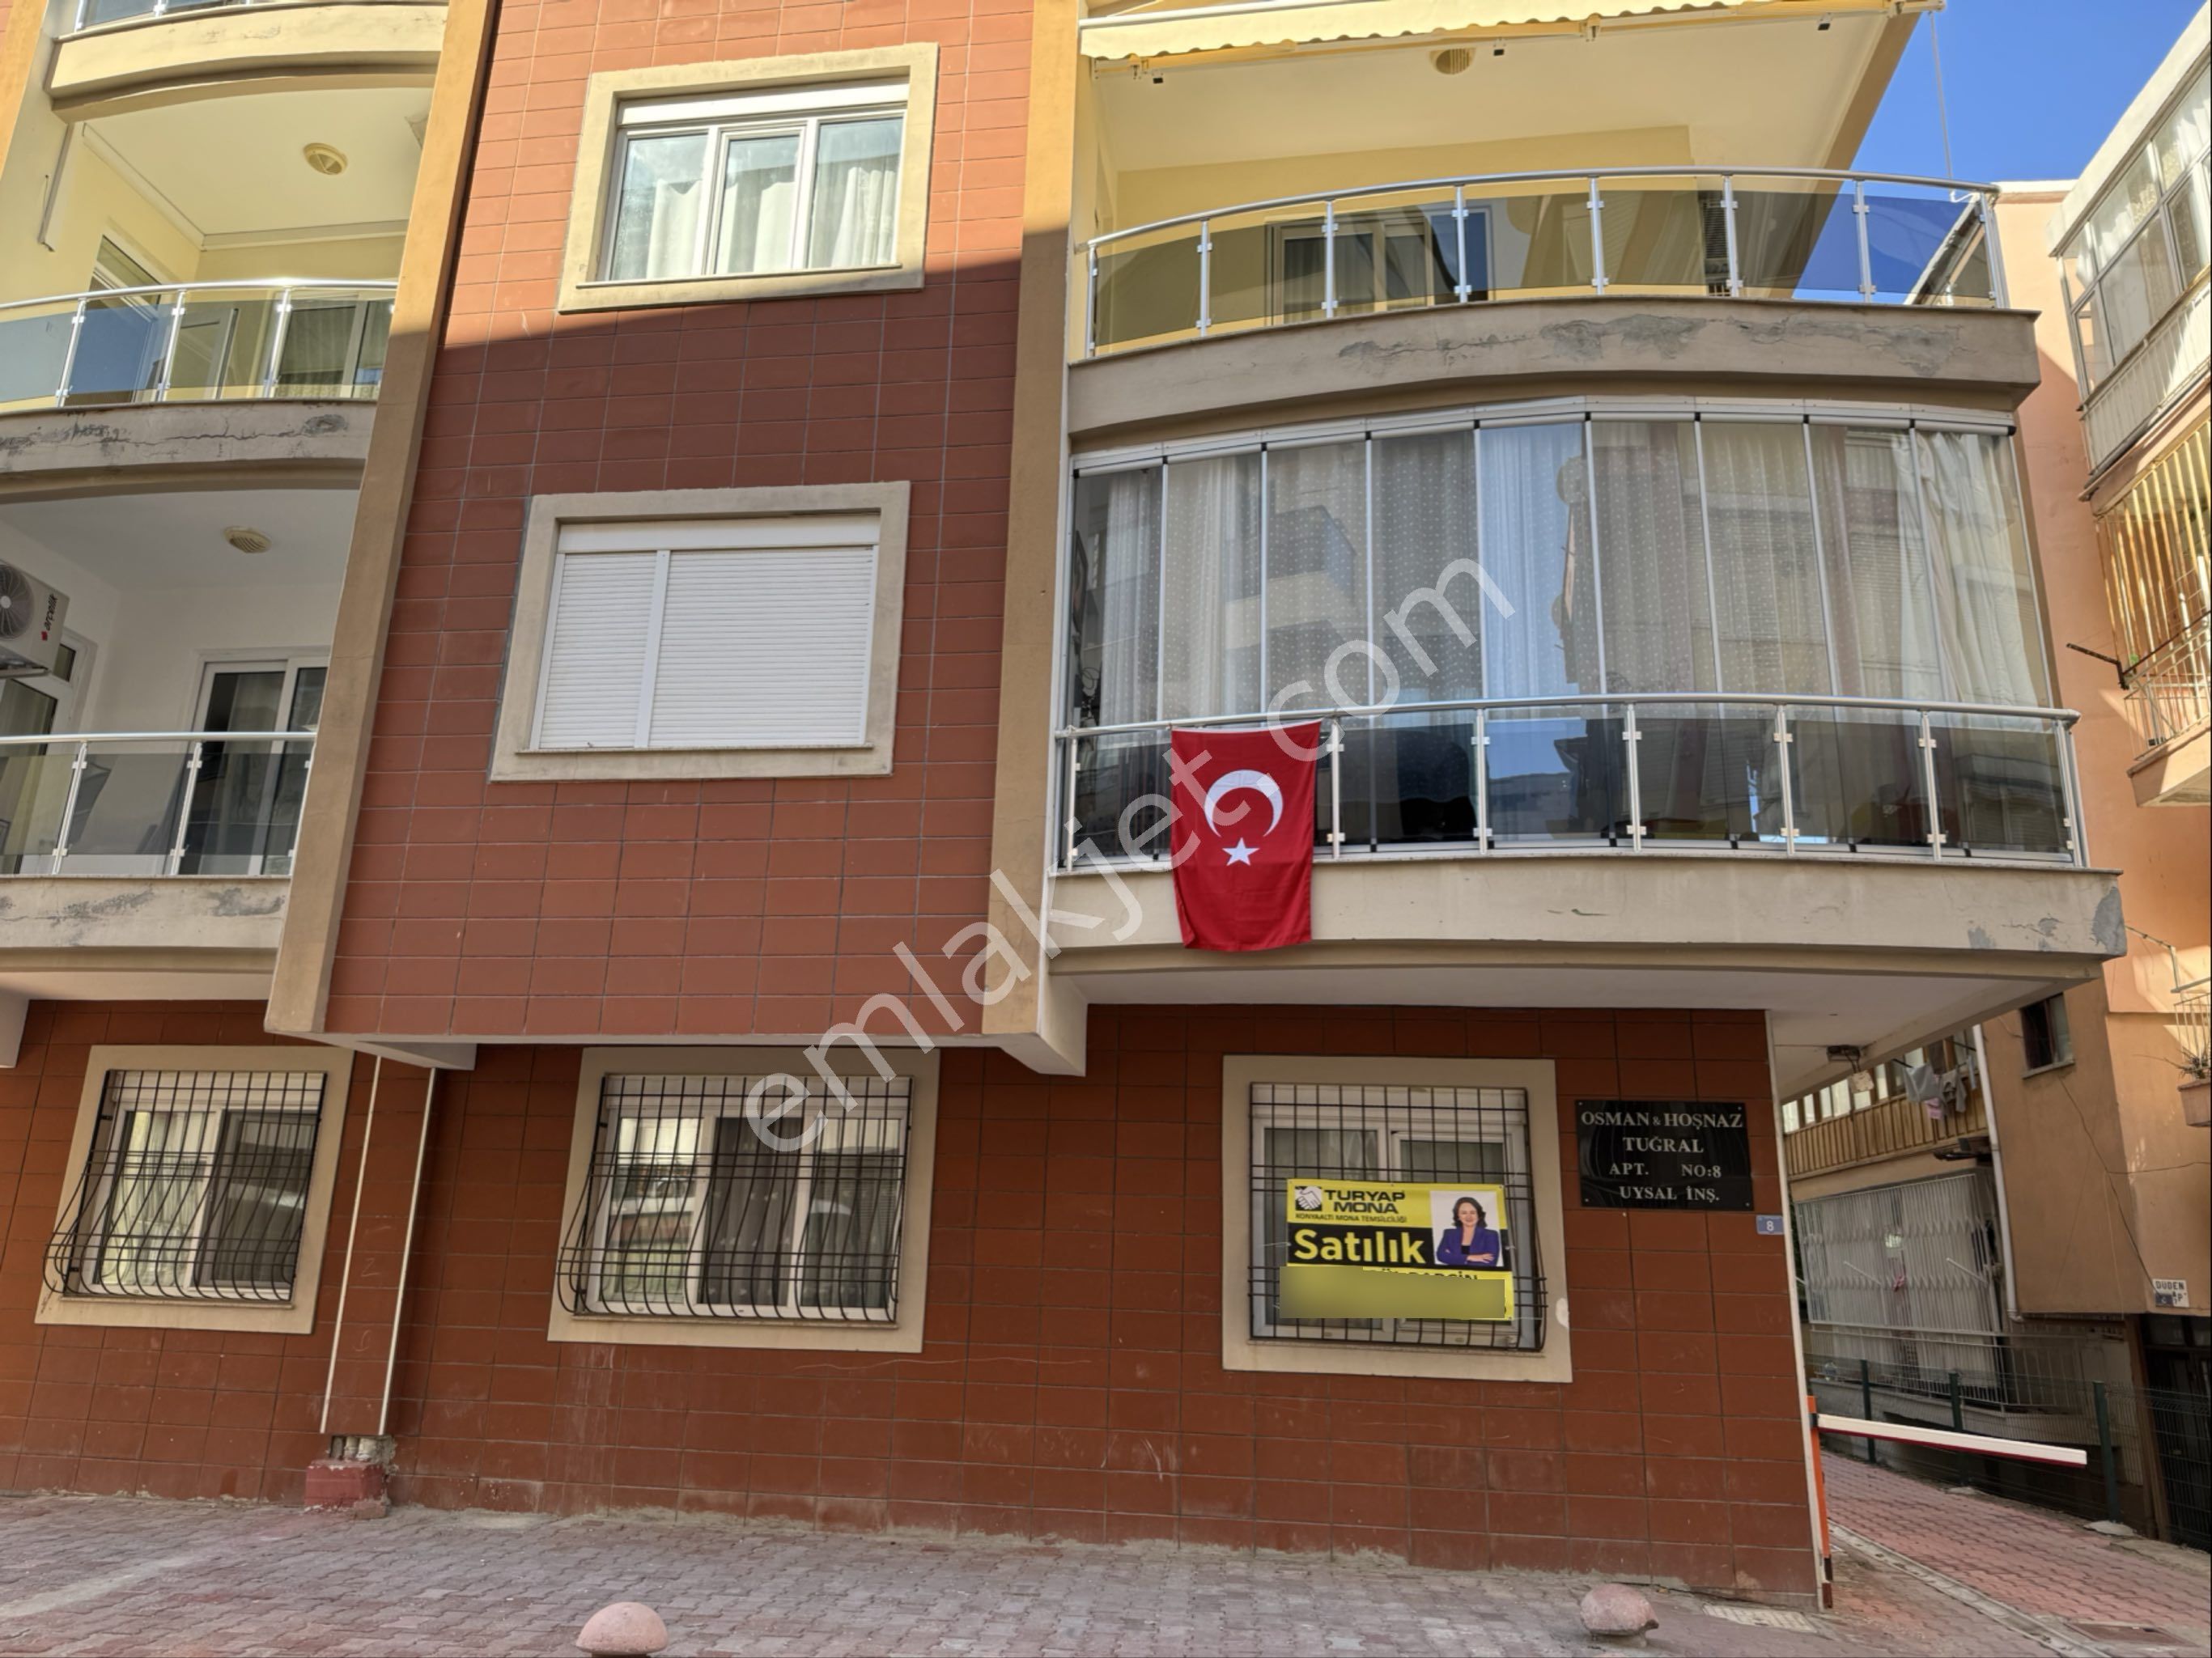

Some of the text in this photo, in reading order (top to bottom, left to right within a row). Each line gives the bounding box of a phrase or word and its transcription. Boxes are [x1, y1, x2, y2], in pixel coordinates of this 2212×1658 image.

[1581, 1111, 1743, 1130] OSMAN & HOŞNAZ
[1622, 1135, 1705, 1153] TUĞRAL
[1609, 1163, 1722, 1178] APT. NO:8
[1324, 1189, 1406, 1202] TURYAP
[1618, 1185, 1721, 1203] UYSAL İNŞ.
[1333, 1202, 1399, 1215] MONA
[1766, 1220, 1774, 1232] 8
[1294, 1228, 1427, 1264] Satılık
